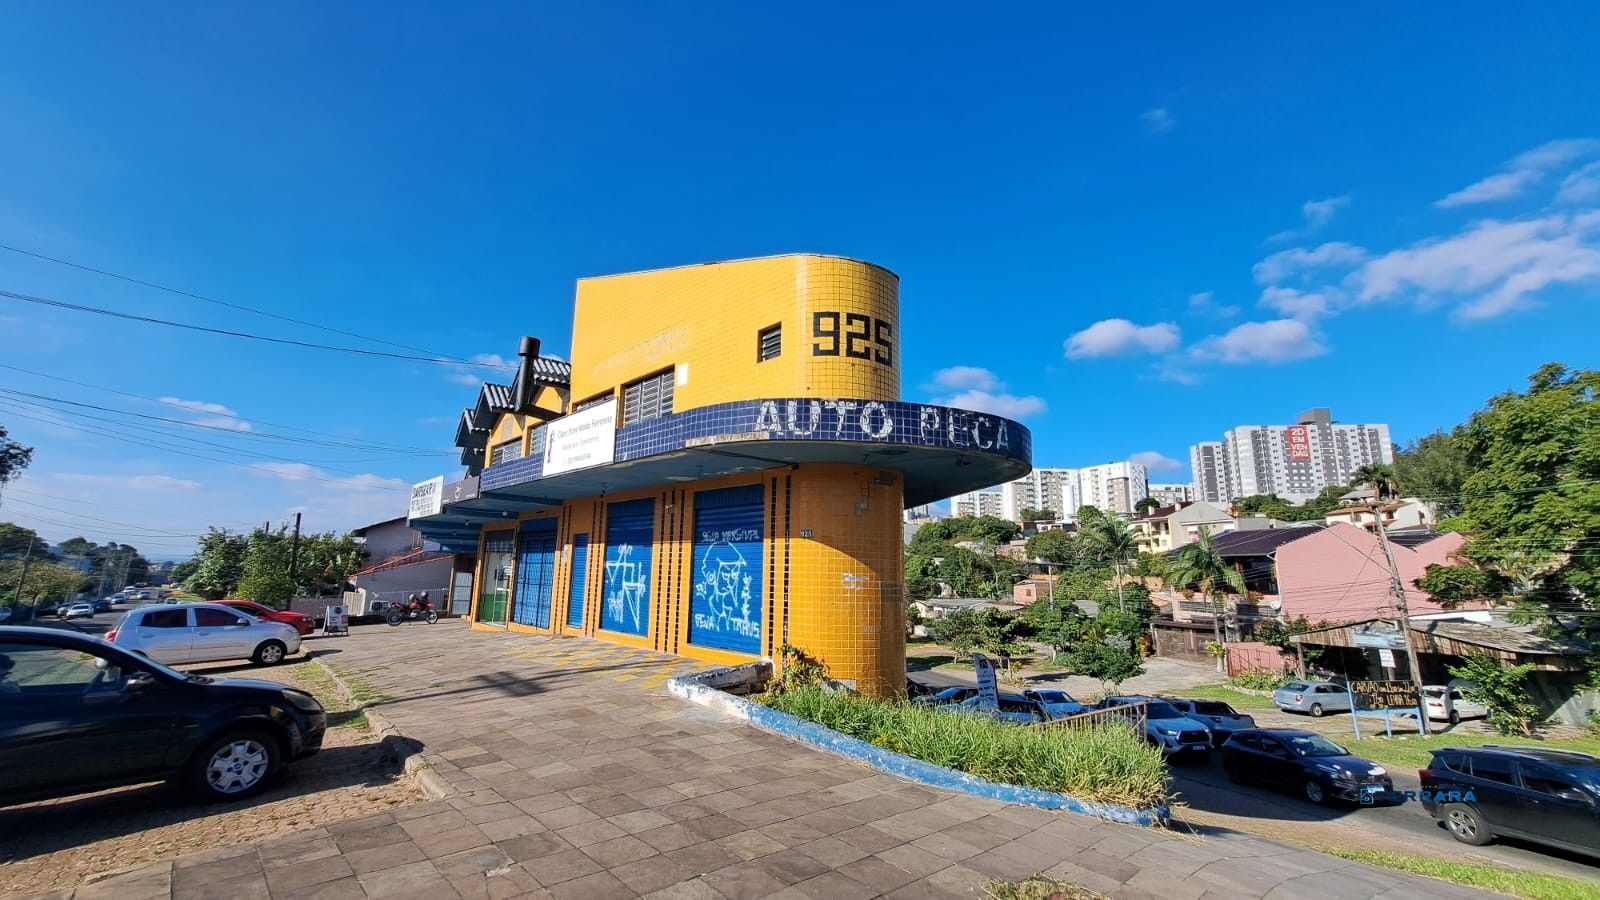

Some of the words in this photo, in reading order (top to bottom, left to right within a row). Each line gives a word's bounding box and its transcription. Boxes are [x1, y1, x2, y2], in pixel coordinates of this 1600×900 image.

[813, 311, 892, 367] 925
[754, 400, 893, 437] AUTO
[1290, 443, 1308, 451] VEN
[800, 529, 812, 537] 925
